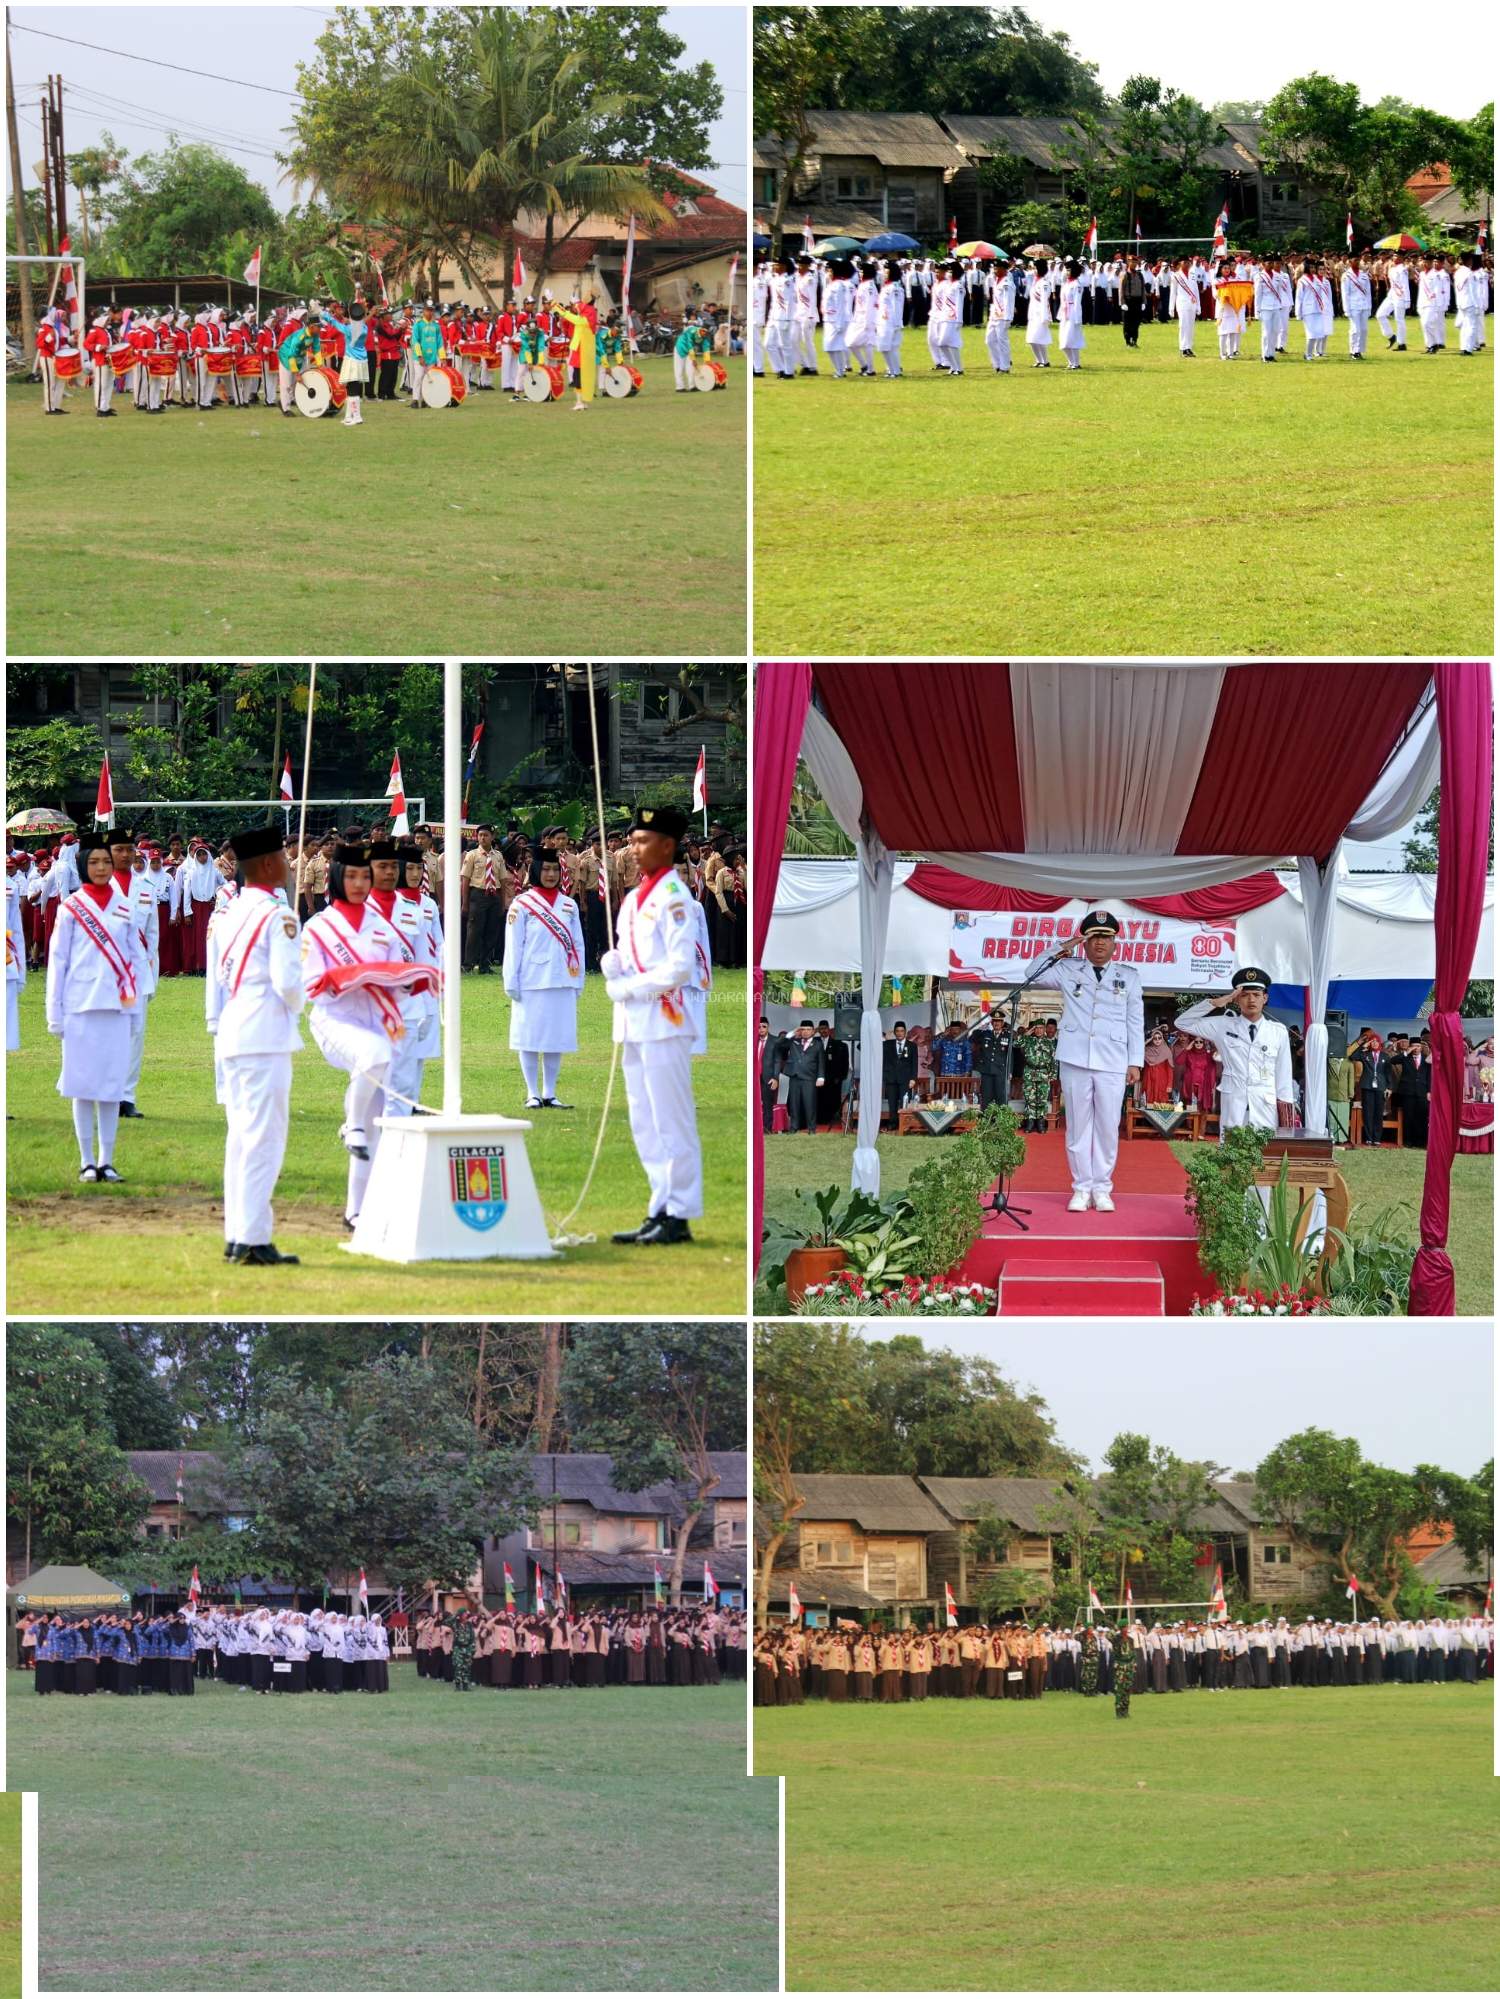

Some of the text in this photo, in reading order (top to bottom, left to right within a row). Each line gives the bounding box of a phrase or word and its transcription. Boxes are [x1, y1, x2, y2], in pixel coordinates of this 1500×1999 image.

[1011, 916, 1160, 940] DIRGAYU
[982, 938, 1177, 963] REPUB IONESIA
[1191, 935, 1221, 957] 80
[450, 1147, 503, 1157] CILACAP
